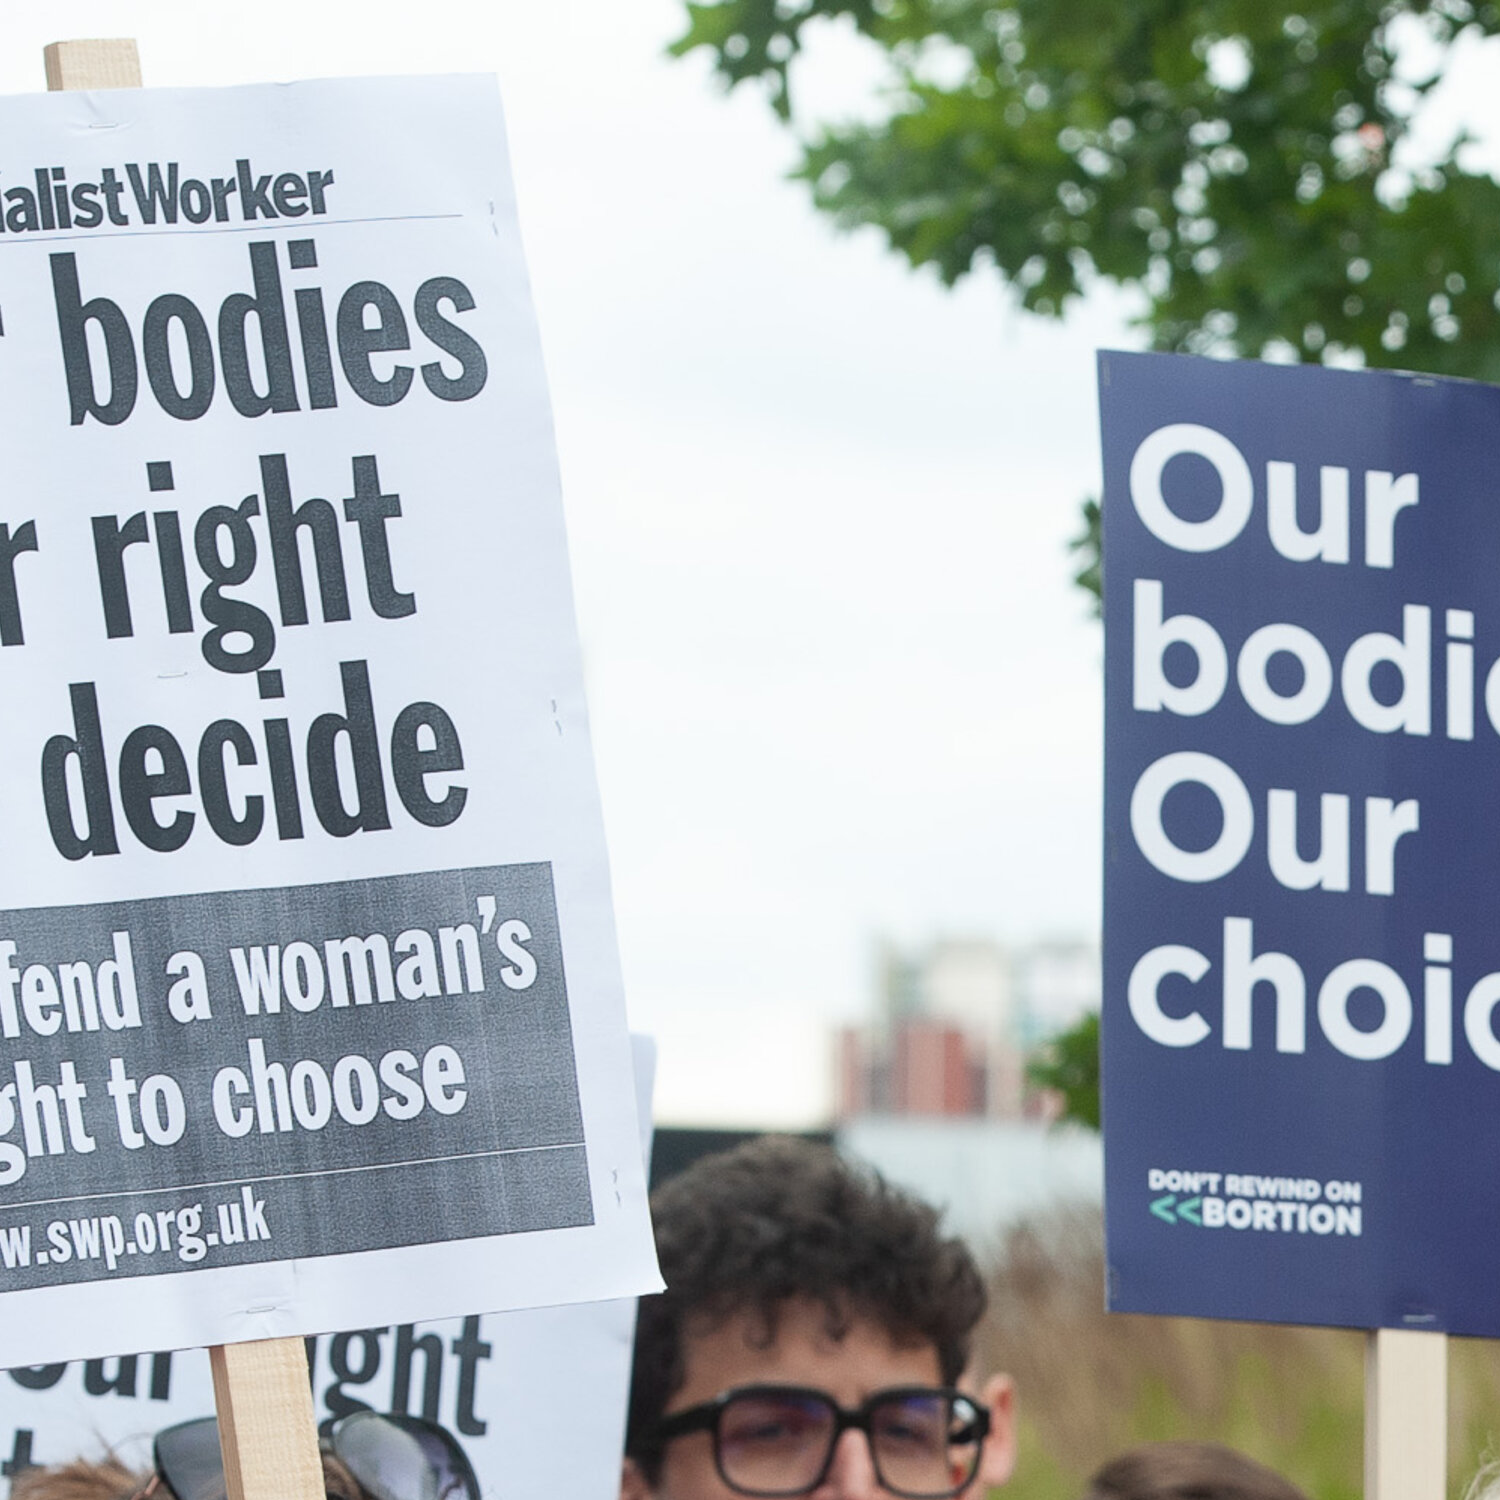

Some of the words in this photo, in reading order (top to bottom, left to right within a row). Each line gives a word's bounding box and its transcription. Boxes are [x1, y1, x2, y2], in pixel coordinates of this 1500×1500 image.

[0, 167, 128, 233] alist
[49, 239, 488, 425] bodies
[91, 453, 417, 674] right
[1129, 423, 1419, 568] Our
[41, 659, 468, 861] decide
[1130, 751, 1419, 895] Our
[0, 931, 142, 1038] fend
[167, 948, 212, 1024] a
[230, 895, 538, 1017] woman's
[108, 1057, 186, 1149] to
[212, 1038, 467, 1138] choose
[1148, 1168, 1222, 1195] DON'T
[1225, 1174, 1322, 1201] REWIND
[1324, 1180, 1362, 1203] ON
